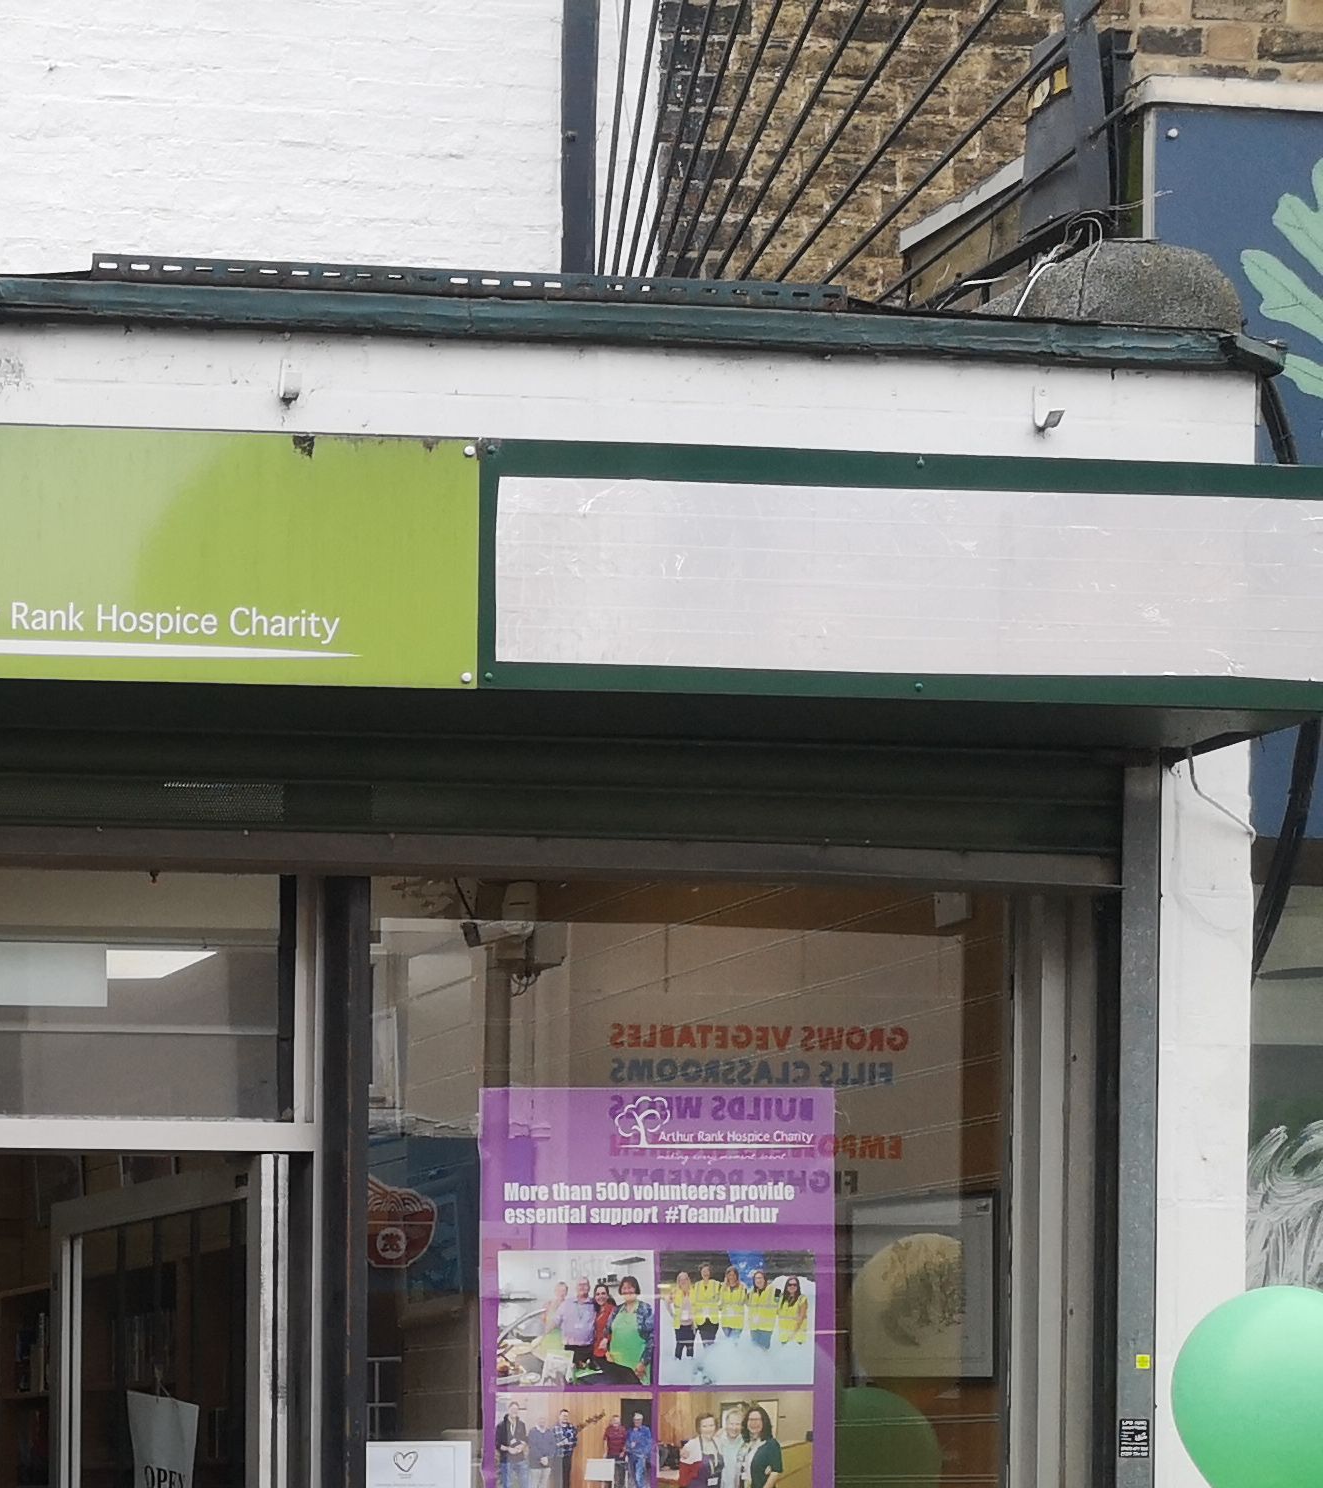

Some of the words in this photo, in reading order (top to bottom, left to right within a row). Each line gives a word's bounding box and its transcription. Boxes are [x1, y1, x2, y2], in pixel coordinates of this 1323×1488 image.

[11, 600, 85, 633] Rank
[97, 601, 219, 641] Hospice
[229, 605, 340, 646] Charity
[658, 1131, 695, 1142] Arthur
[698, 1131, 724, 1142] Rank
[727, 1131, 770, 1144] Hospice
[773, 1131, 814, 1145] Charity
[504, 1182, 548, 1202] More
[553, 1182, 591, 1201] than
[595, 1181, 629, 1201] 500
[633, 1181, 726, 1201] volunteers
[730, 1180, 795, 1203] provide
[504, 1204, 586, 1225] essential
[590, 1204, 659, 1226] support
[665, 1204, 779, 1224] #TeamArthur
